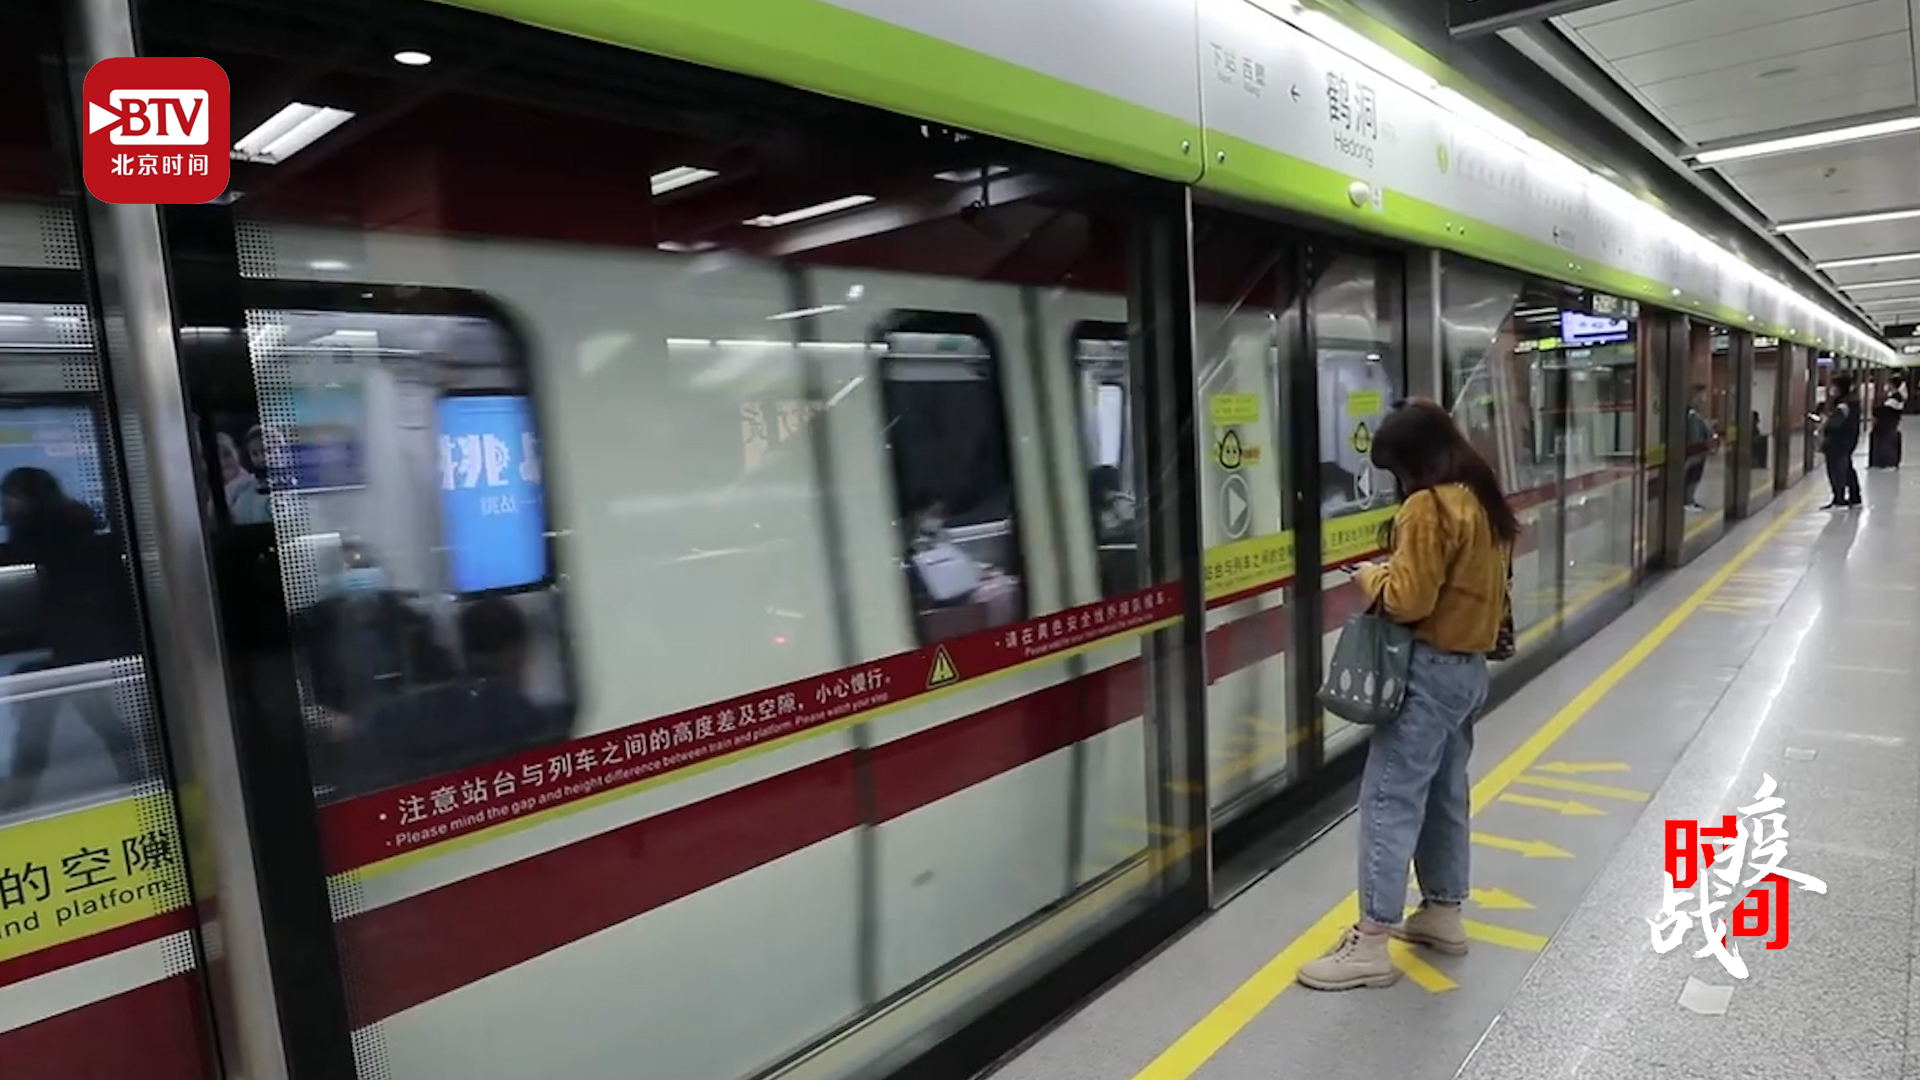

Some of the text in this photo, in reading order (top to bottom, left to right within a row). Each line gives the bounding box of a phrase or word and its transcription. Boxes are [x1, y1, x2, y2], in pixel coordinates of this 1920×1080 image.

[396, 825, 447, 847] Please
[451, 809, 485, 829] mind
[487, 803, 509, 819] the
[512, 797, 536, 816] gap
[539, 788, 562, 804] and
[564, 774, 604, 796] height
[605, 759, 661, 783] difference
[0, 878, 171, 940] nd platform
